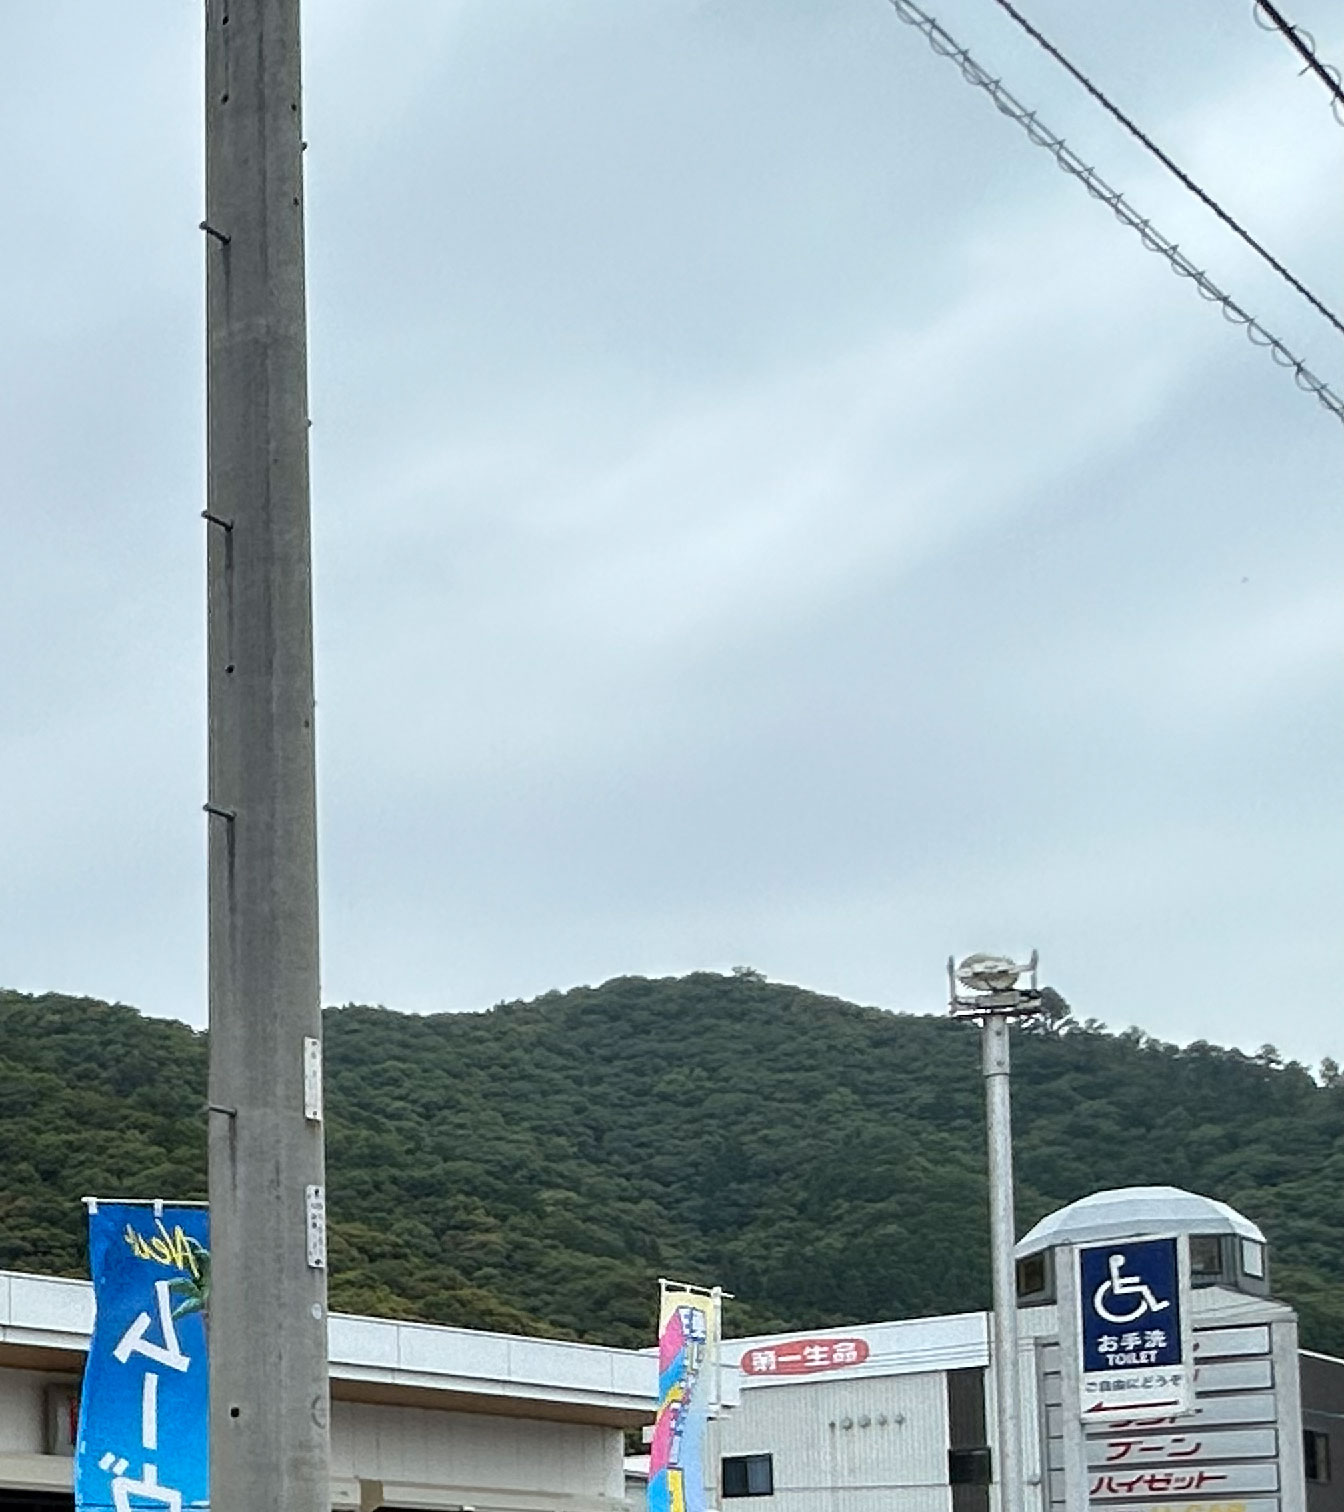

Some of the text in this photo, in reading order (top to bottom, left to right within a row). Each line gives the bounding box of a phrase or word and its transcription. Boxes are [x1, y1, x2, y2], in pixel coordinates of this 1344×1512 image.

[1097, 1329, 1168, 1353] お手洗
[1106, 1350, 1159, 1366] TOILET
[1089, 1471, 1228, 1496] ハイゼット
